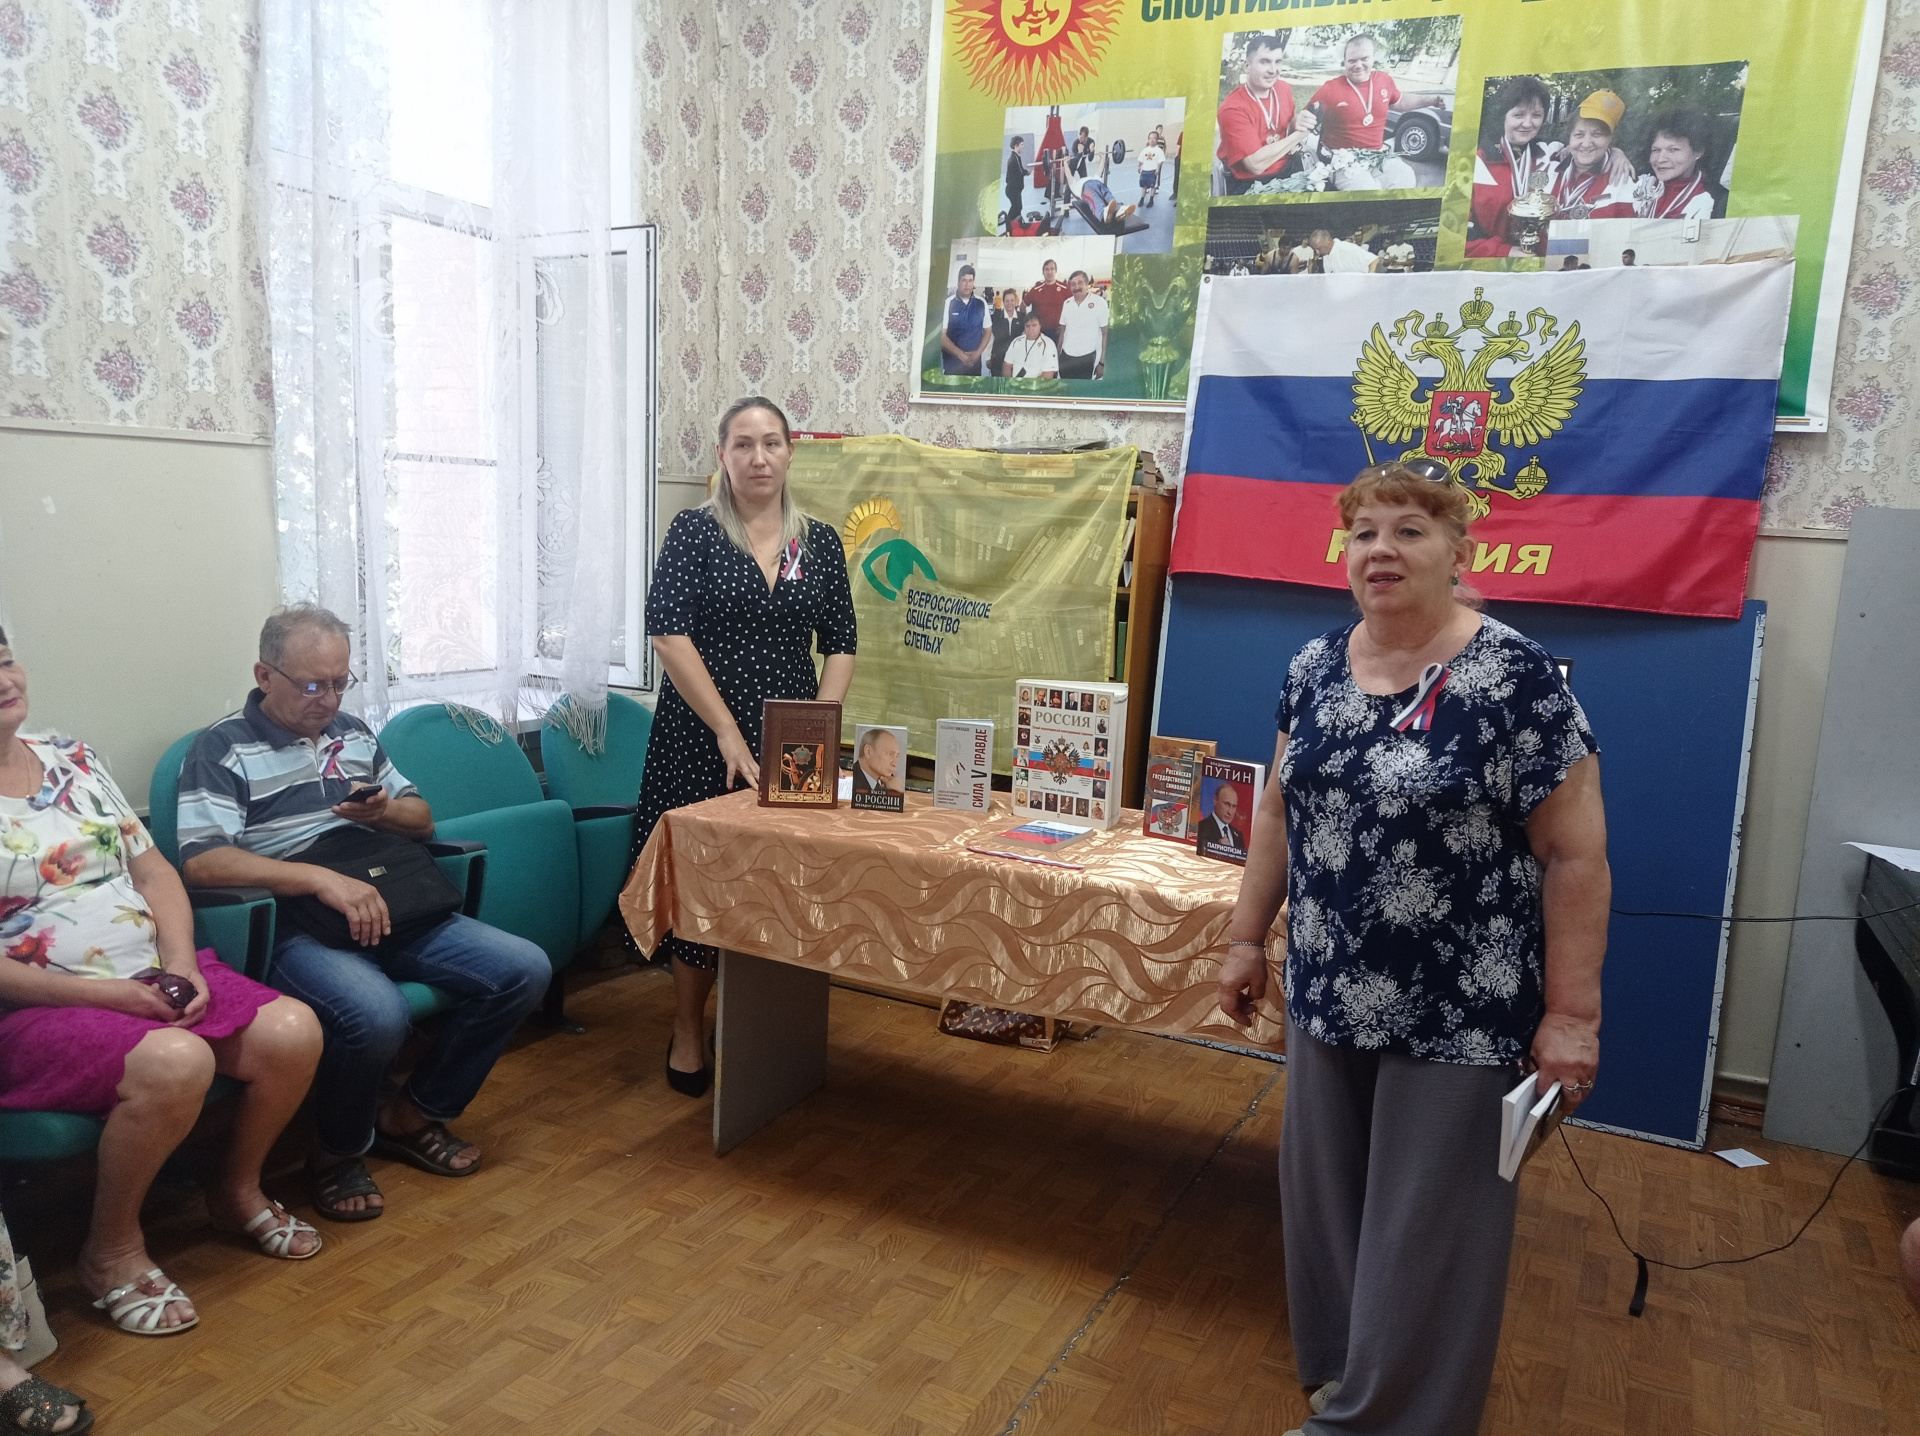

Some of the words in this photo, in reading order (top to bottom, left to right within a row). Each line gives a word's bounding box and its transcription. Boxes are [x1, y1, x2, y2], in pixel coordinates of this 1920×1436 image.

[1141, 0, 1371, 23] Спортив
[1325, 528, 1553, 576] РИЯ
[907, 589, 992, 618] ВСЕРОССИЙСКОЕ
[906, 608, 960, 634] ОБЩЕСТВО
[904, 629, 944, 655] СЛЕПЫХ
[1035, 711, 1091, 728] РОССИЯ
[974, 728, 988, 766] ПРАВДЕ
[971, 769, 988, 779] V
[1165, 767, 1192, 779] Российская
[1204, 764, 1252, 784] ПУТИН
[855, 793, 862, 803] О
[865, 794, 900, 807] РОССИИ
[972, 782, 985, 808] СИЛА
[1207, 841, 1242, 855] ПАТРИОТИЗМ
